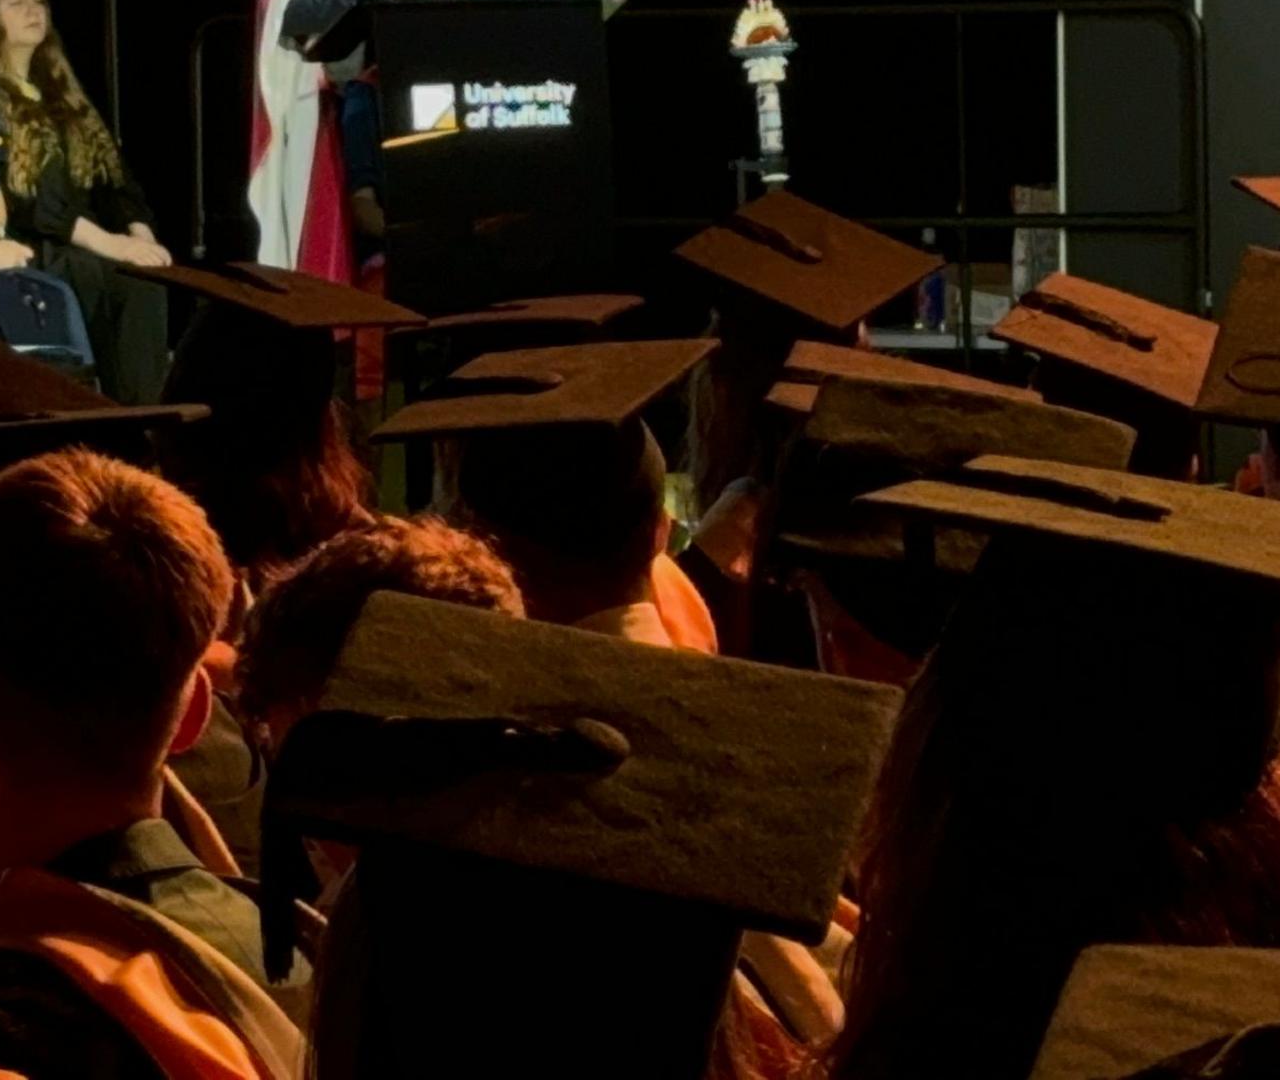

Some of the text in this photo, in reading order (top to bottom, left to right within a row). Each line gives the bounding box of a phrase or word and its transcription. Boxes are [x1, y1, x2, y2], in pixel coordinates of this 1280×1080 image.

[463, 80, 576, 106] University
[465, 103, 571, 129] of Suffolk
